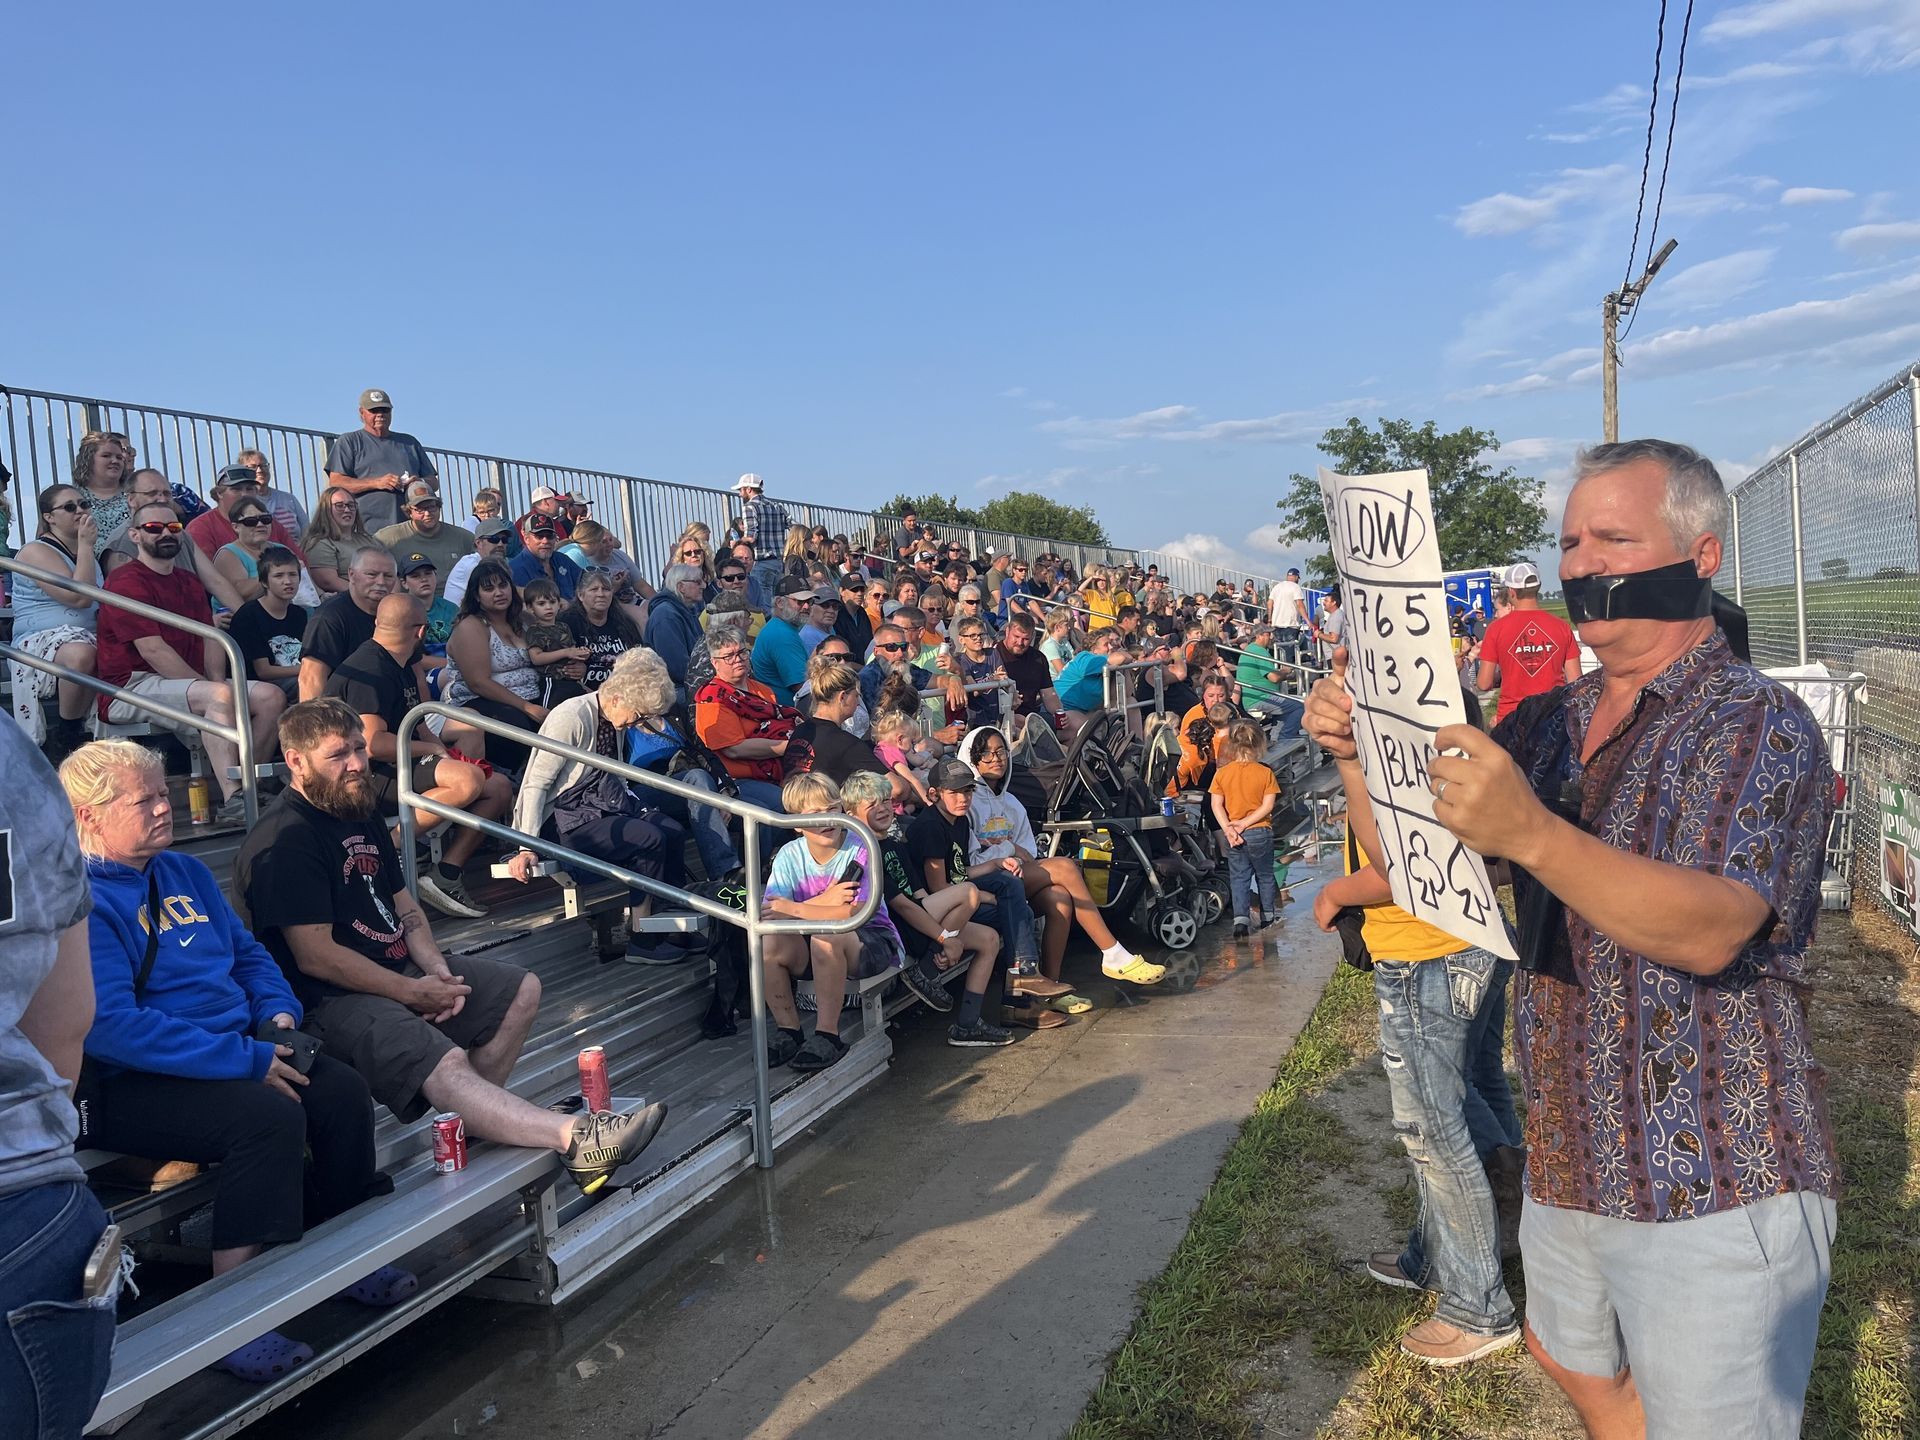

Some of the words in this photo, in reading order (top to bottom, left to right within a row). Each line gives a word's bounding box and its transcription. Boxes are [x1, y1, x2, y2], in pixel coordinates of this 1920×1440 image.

[1344, 489, 1414, 561] LOW
[1514, 644, 1553, 654] ARIAT
[80, 1099, 89, 1136] lululemon
[583, 1145, 622, 1164] PUMA
